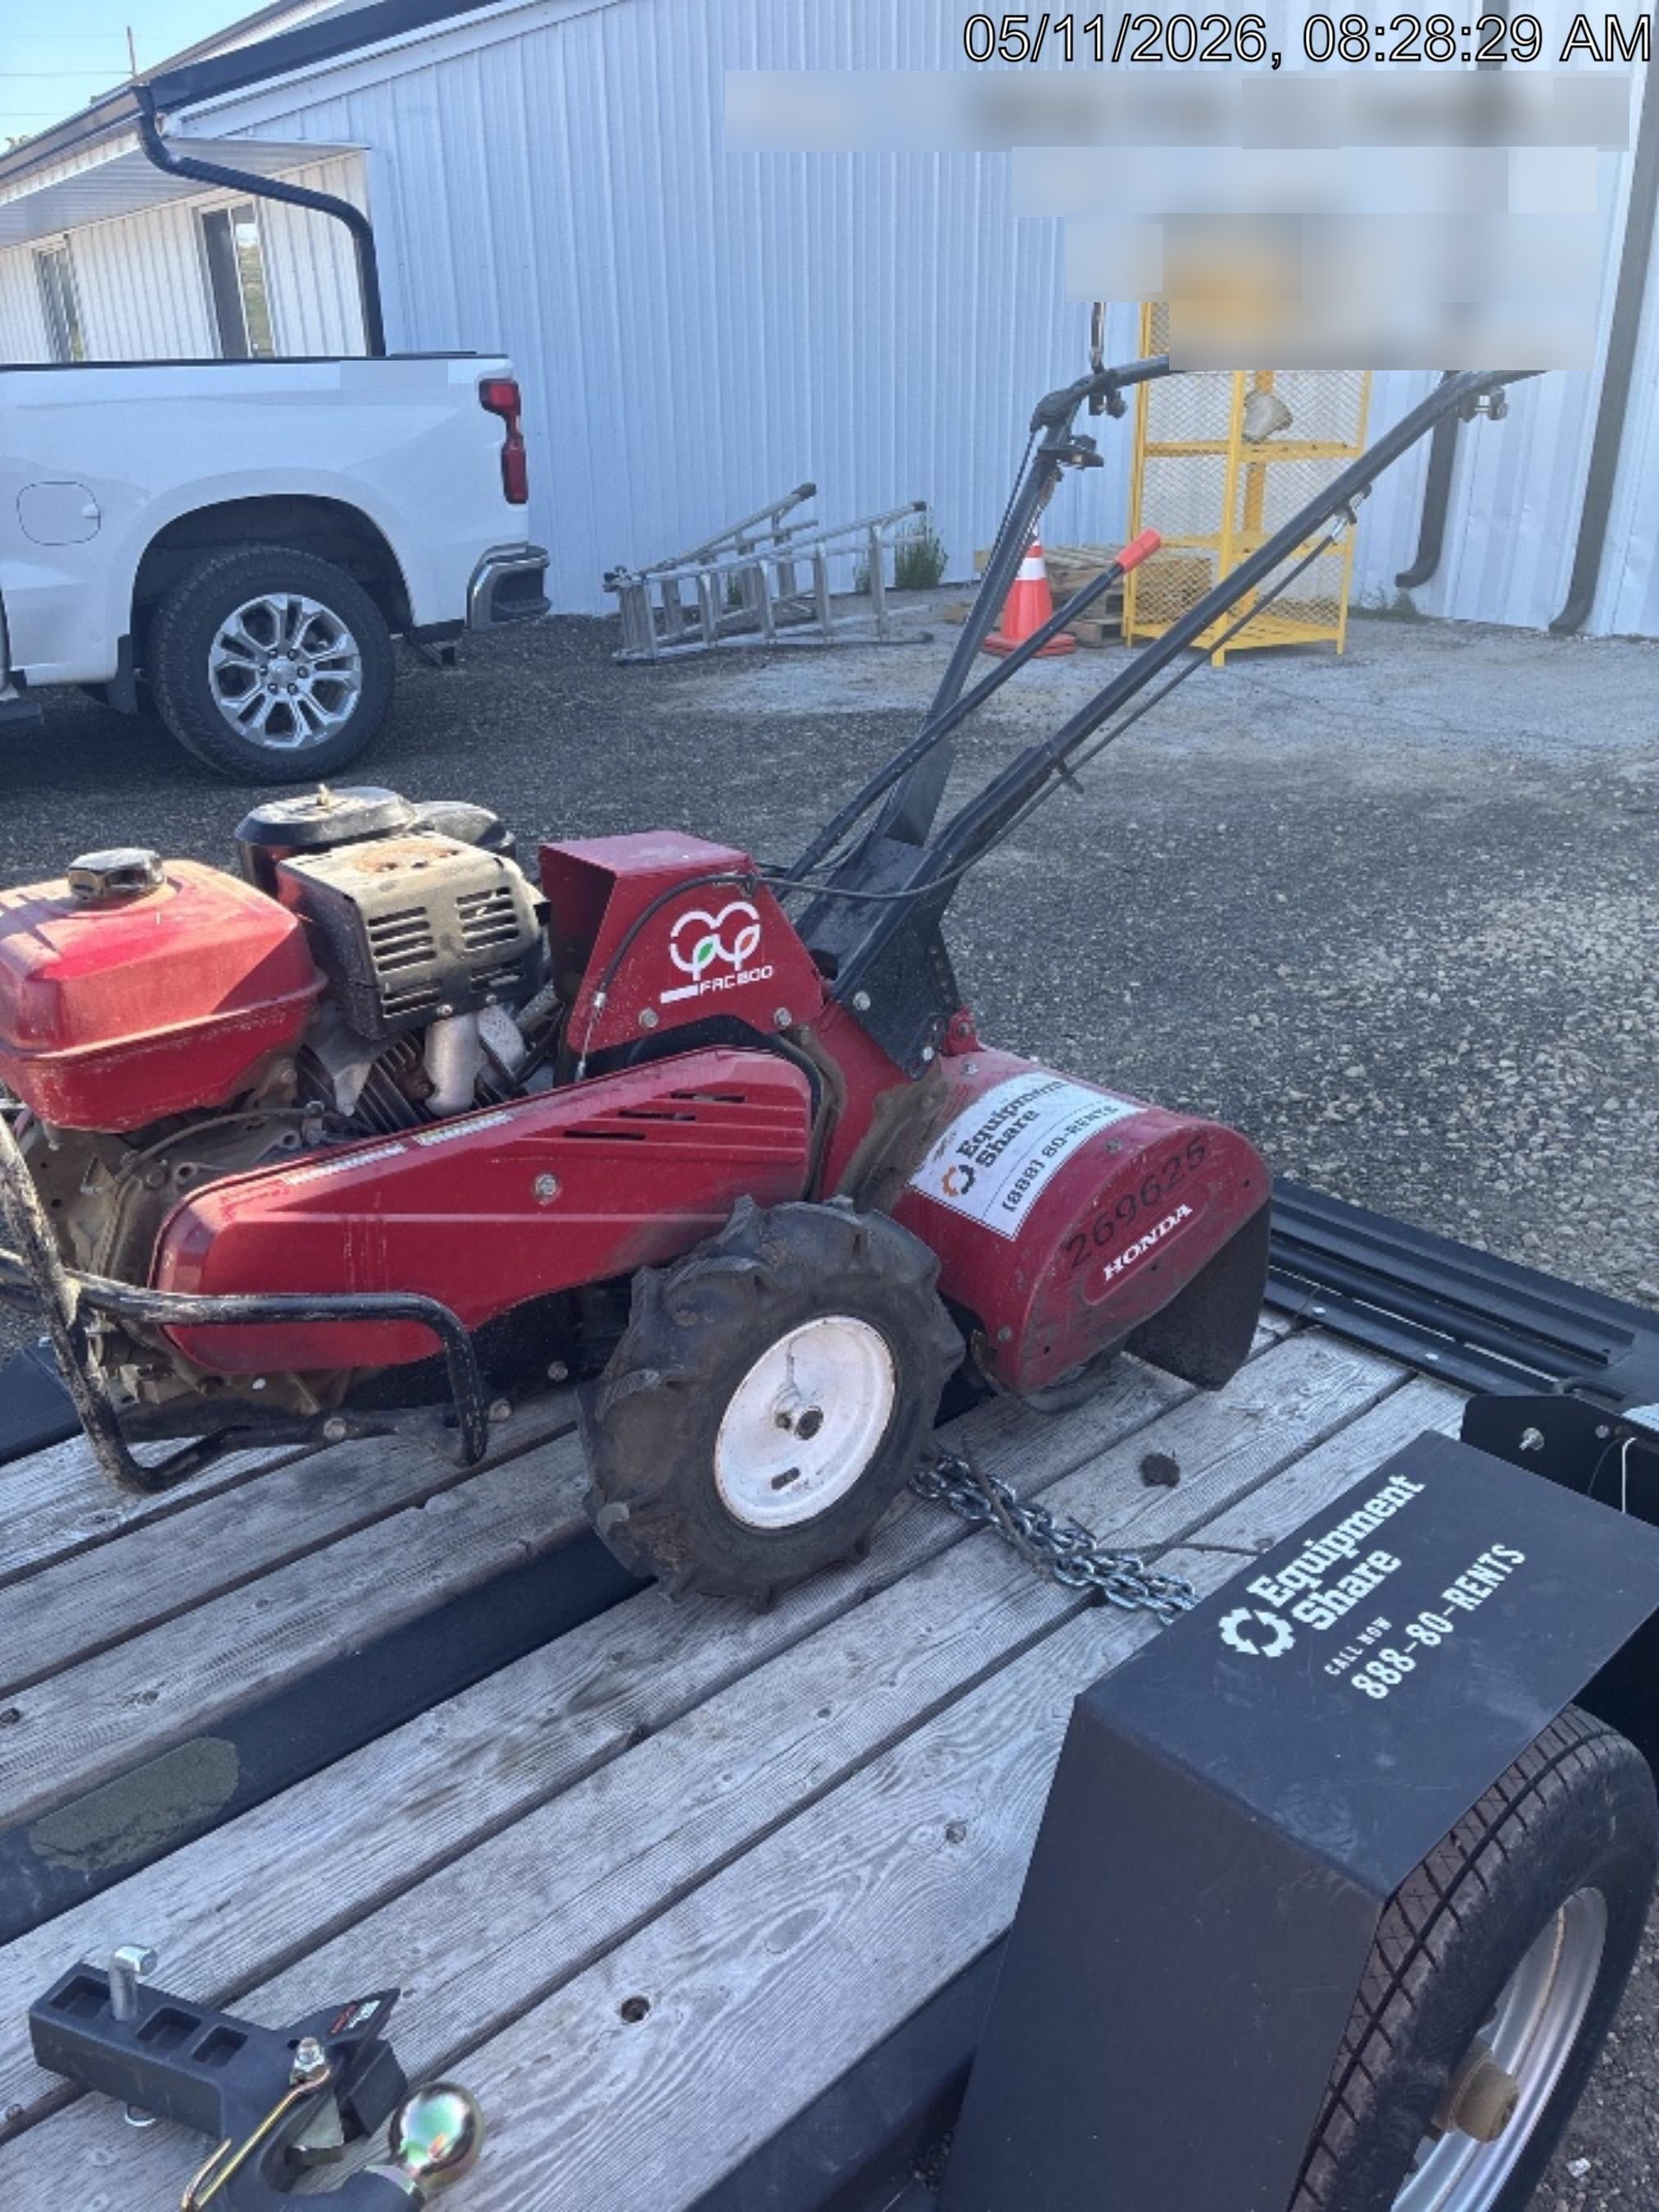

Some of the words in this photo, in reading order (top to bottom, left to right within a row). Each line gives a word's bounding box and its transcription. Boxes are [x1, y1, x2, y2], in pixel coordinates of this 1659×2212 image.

[976, 1109, 1040, 1168] Share
[1002, 1158, 1045, 1213] (888)
[1066, 1133, 1207, 1269] 269625
[1104, 1203, 1194, 1281] HONDA
[1246, 1475, 1426, 1608] Equipment
[1291, 1549, 1402, 1631] Share
[1350, 1543, 1526, 1700] 888-80-RENTS
[1324, 1645, 1363, 1676] CALL
[1356, 1616, 1393, 1646] NOW
